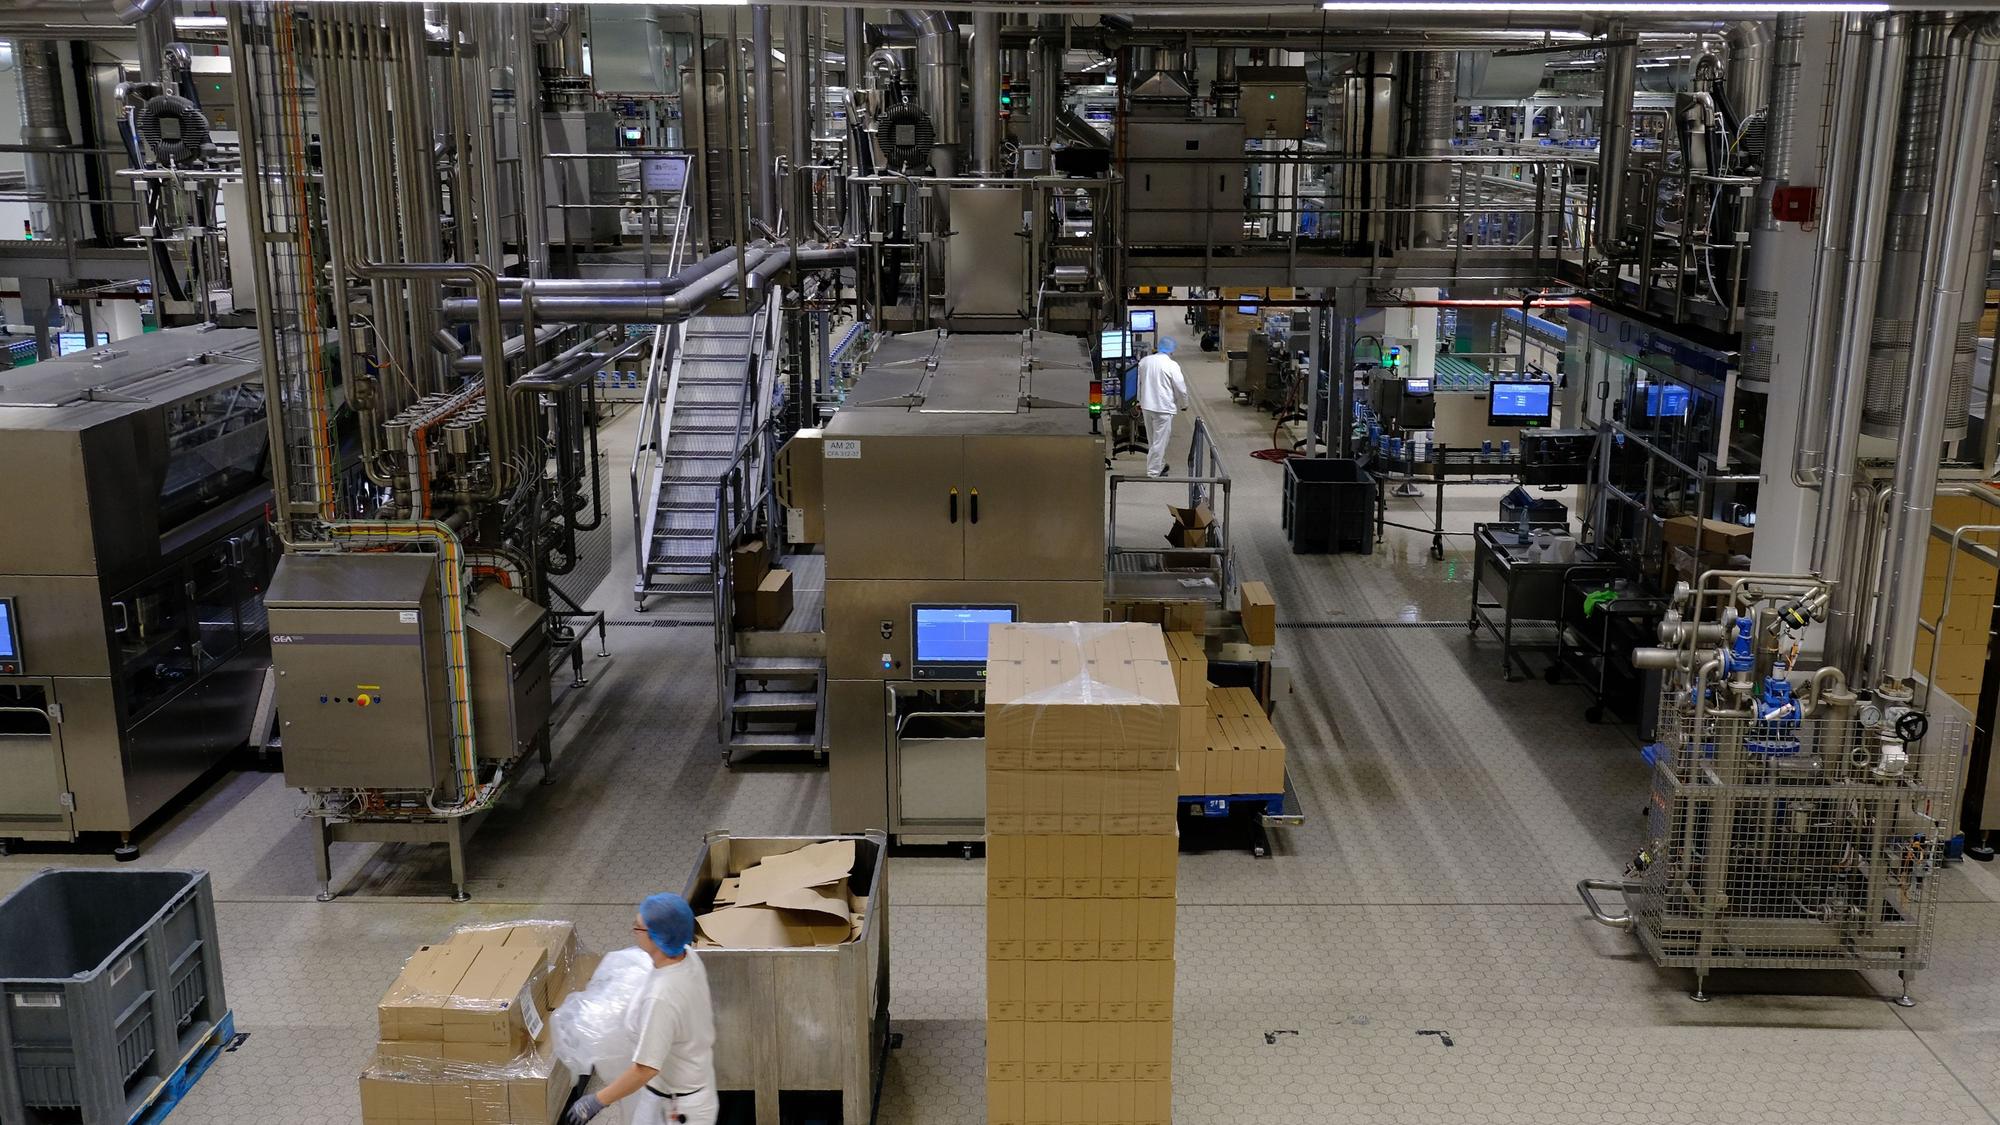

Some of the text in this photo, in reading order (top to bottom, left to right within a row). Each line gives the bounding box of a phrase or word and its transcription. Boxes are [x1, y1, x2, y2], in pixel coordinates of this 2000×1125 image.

[830, 441, 855, 449] AM 20
[272, 635, 293, 643] GEA
